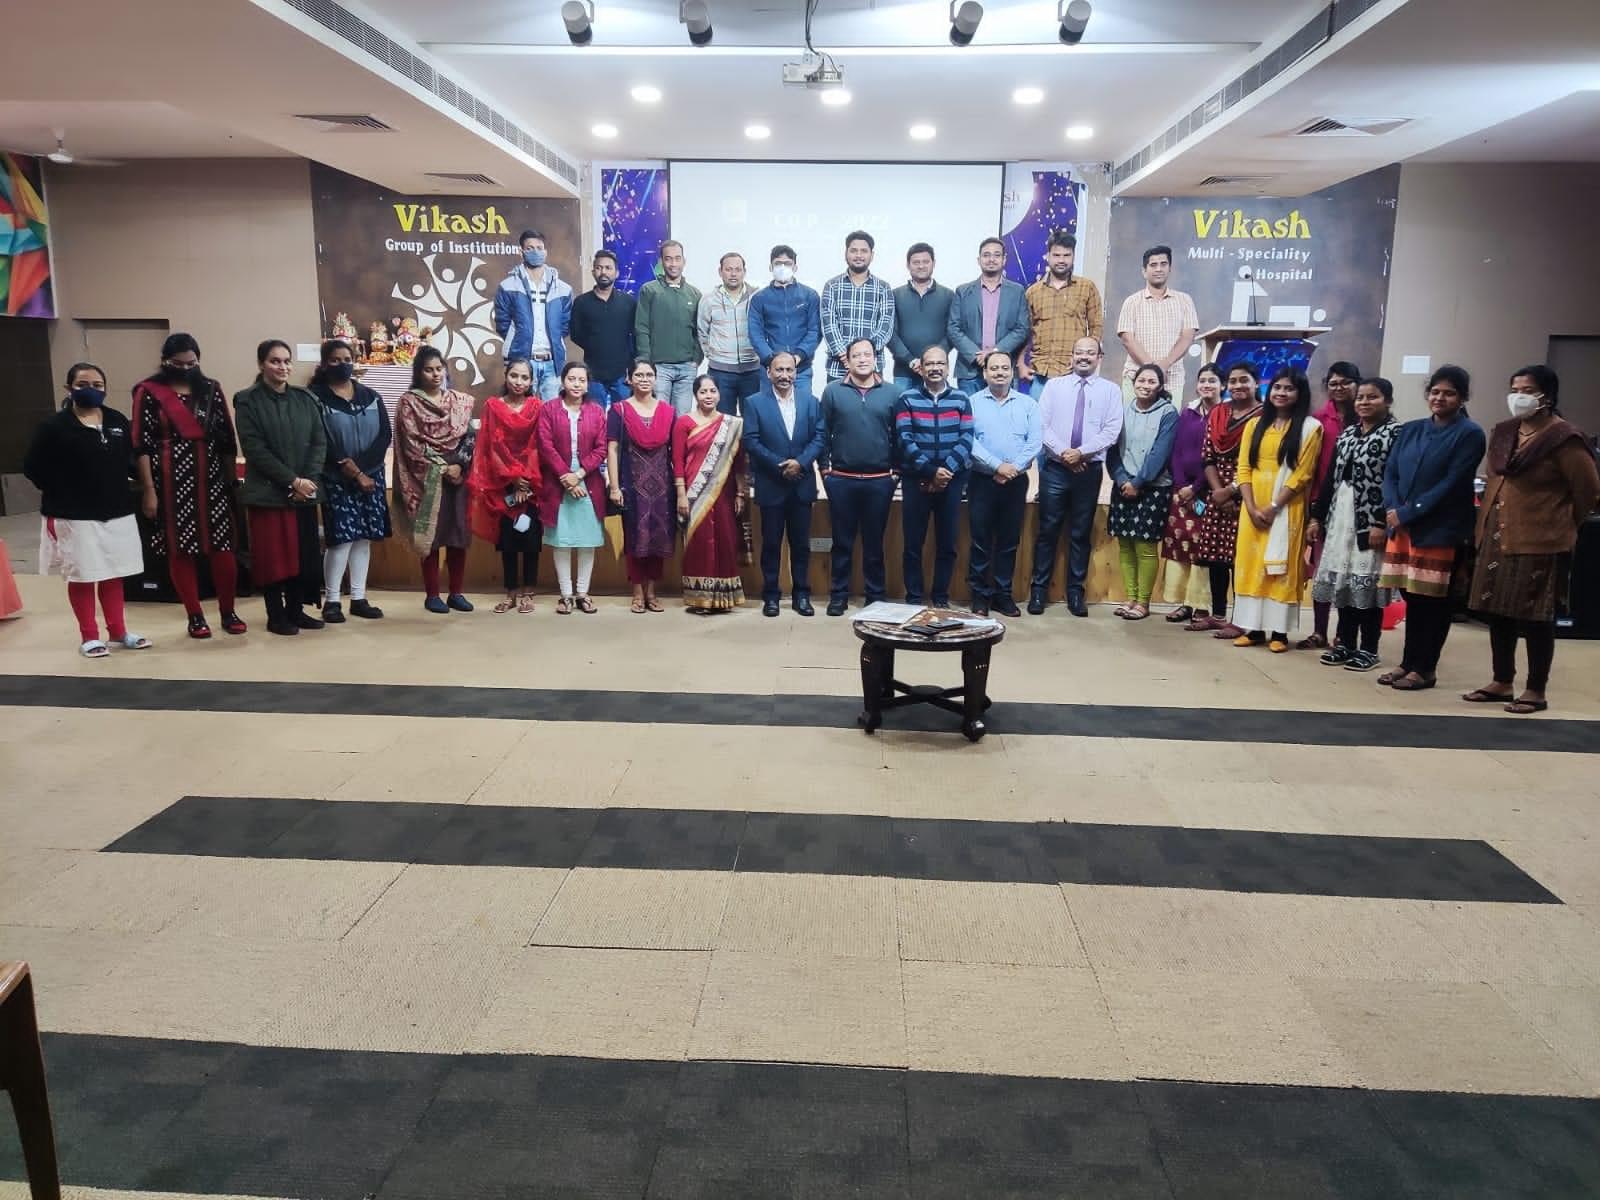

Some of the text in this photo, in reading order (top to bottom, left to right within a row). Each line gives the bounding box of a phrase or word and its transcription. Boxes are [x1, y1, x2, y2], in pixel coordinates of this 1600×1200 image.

[393, 204, 511, 234] Vikash
[1193, 208, 1312, 239] Vikash
[384, 238, 424, 255] Group
[430, 240, 443, 253] of
[1188, 246, 1225, 259] Multi
[1237, 247, 1311, 263] Speciality
[1256, 269, 1313, 282] Hospital
